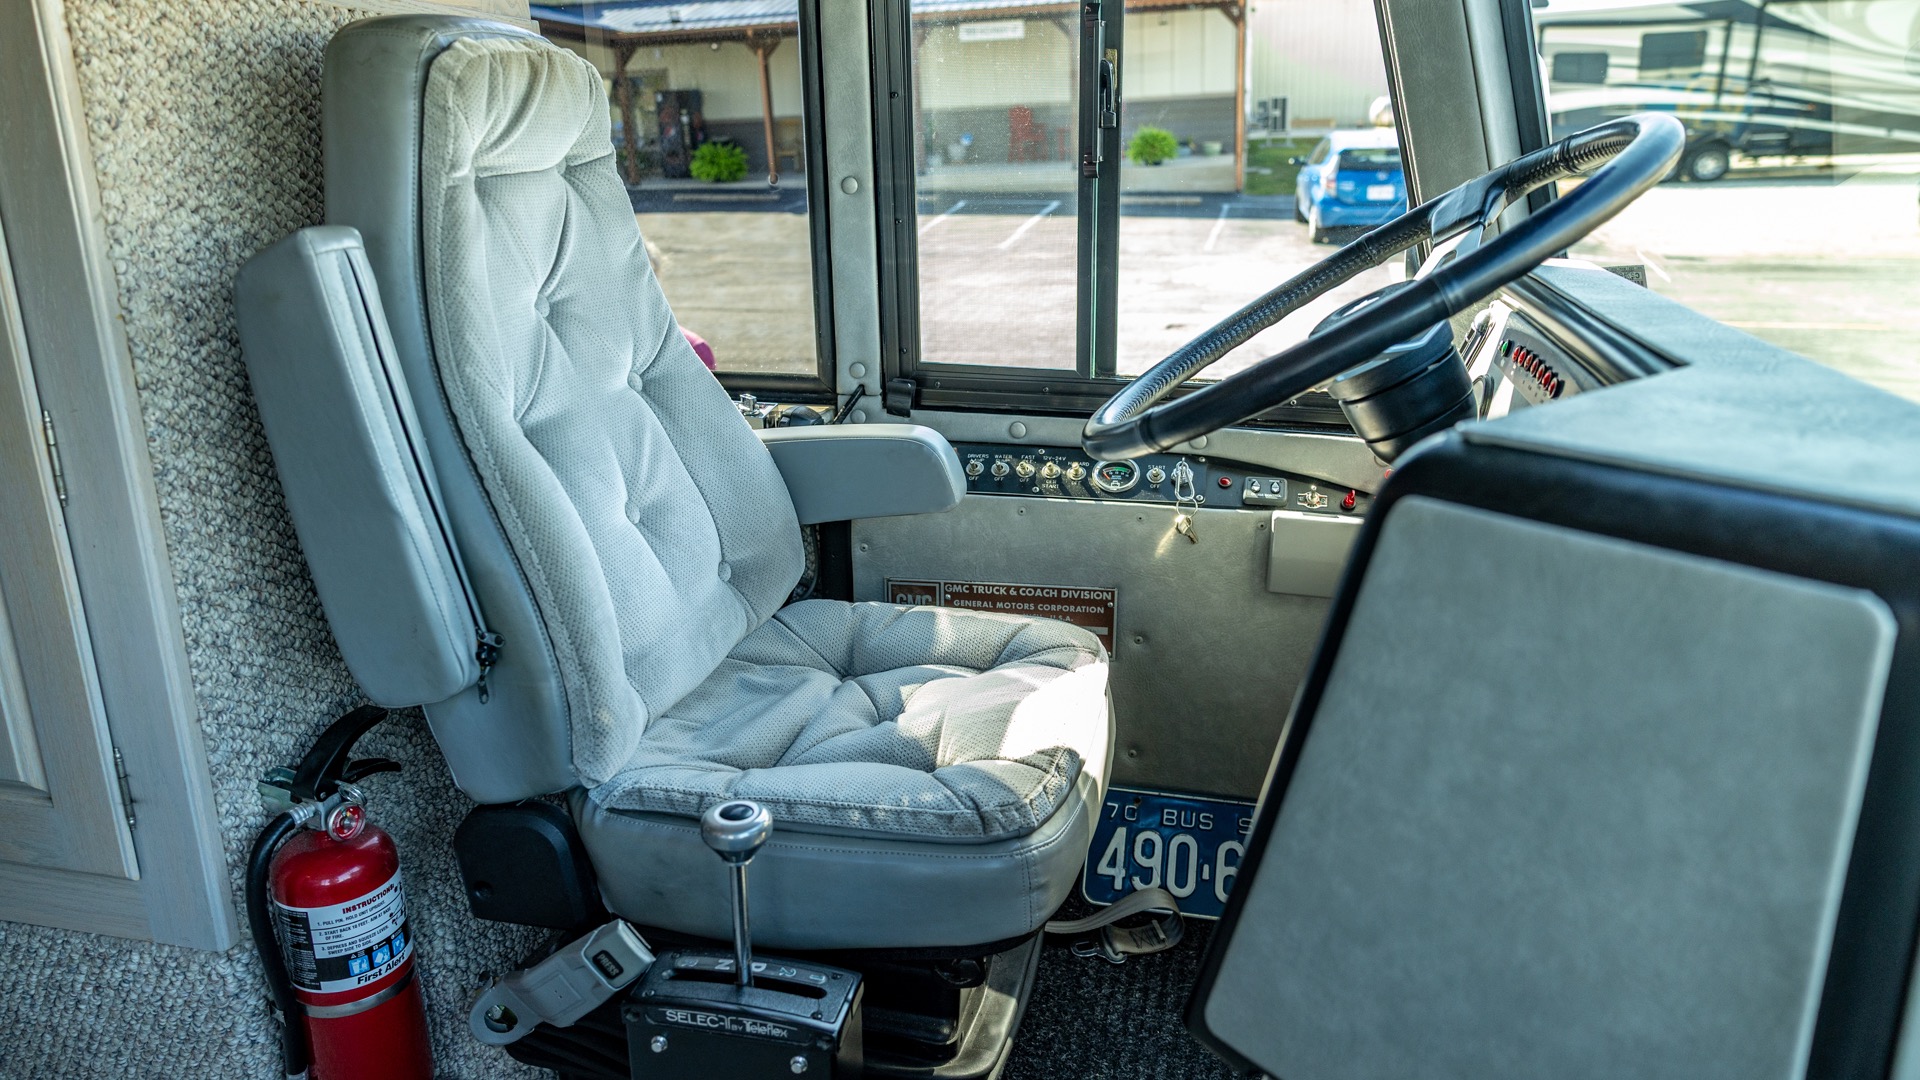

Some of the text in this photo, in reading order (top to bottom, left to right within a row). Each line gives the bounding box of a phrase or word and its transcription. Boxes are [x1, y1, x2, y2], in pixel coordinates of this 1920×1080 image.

[945, 584, 1112, 601] GMC TRUCK & COACH DIVISION
[953, 599, 1104, 614] GENERAL MOTORS CORPORATION
[1163, 808, 1214, 830] BUS
[327, 942, 348, 950] DEPRESS
[358, 933, 377, 943] SQUEEZE
[357, 954, 406, 986] First Alert
[597, 954, 619, 976] PRESS
[714, 959, 734, 970] N
[778, 967, 796, 977] 2
[743, 1019, 788, 1038] Teleflex
